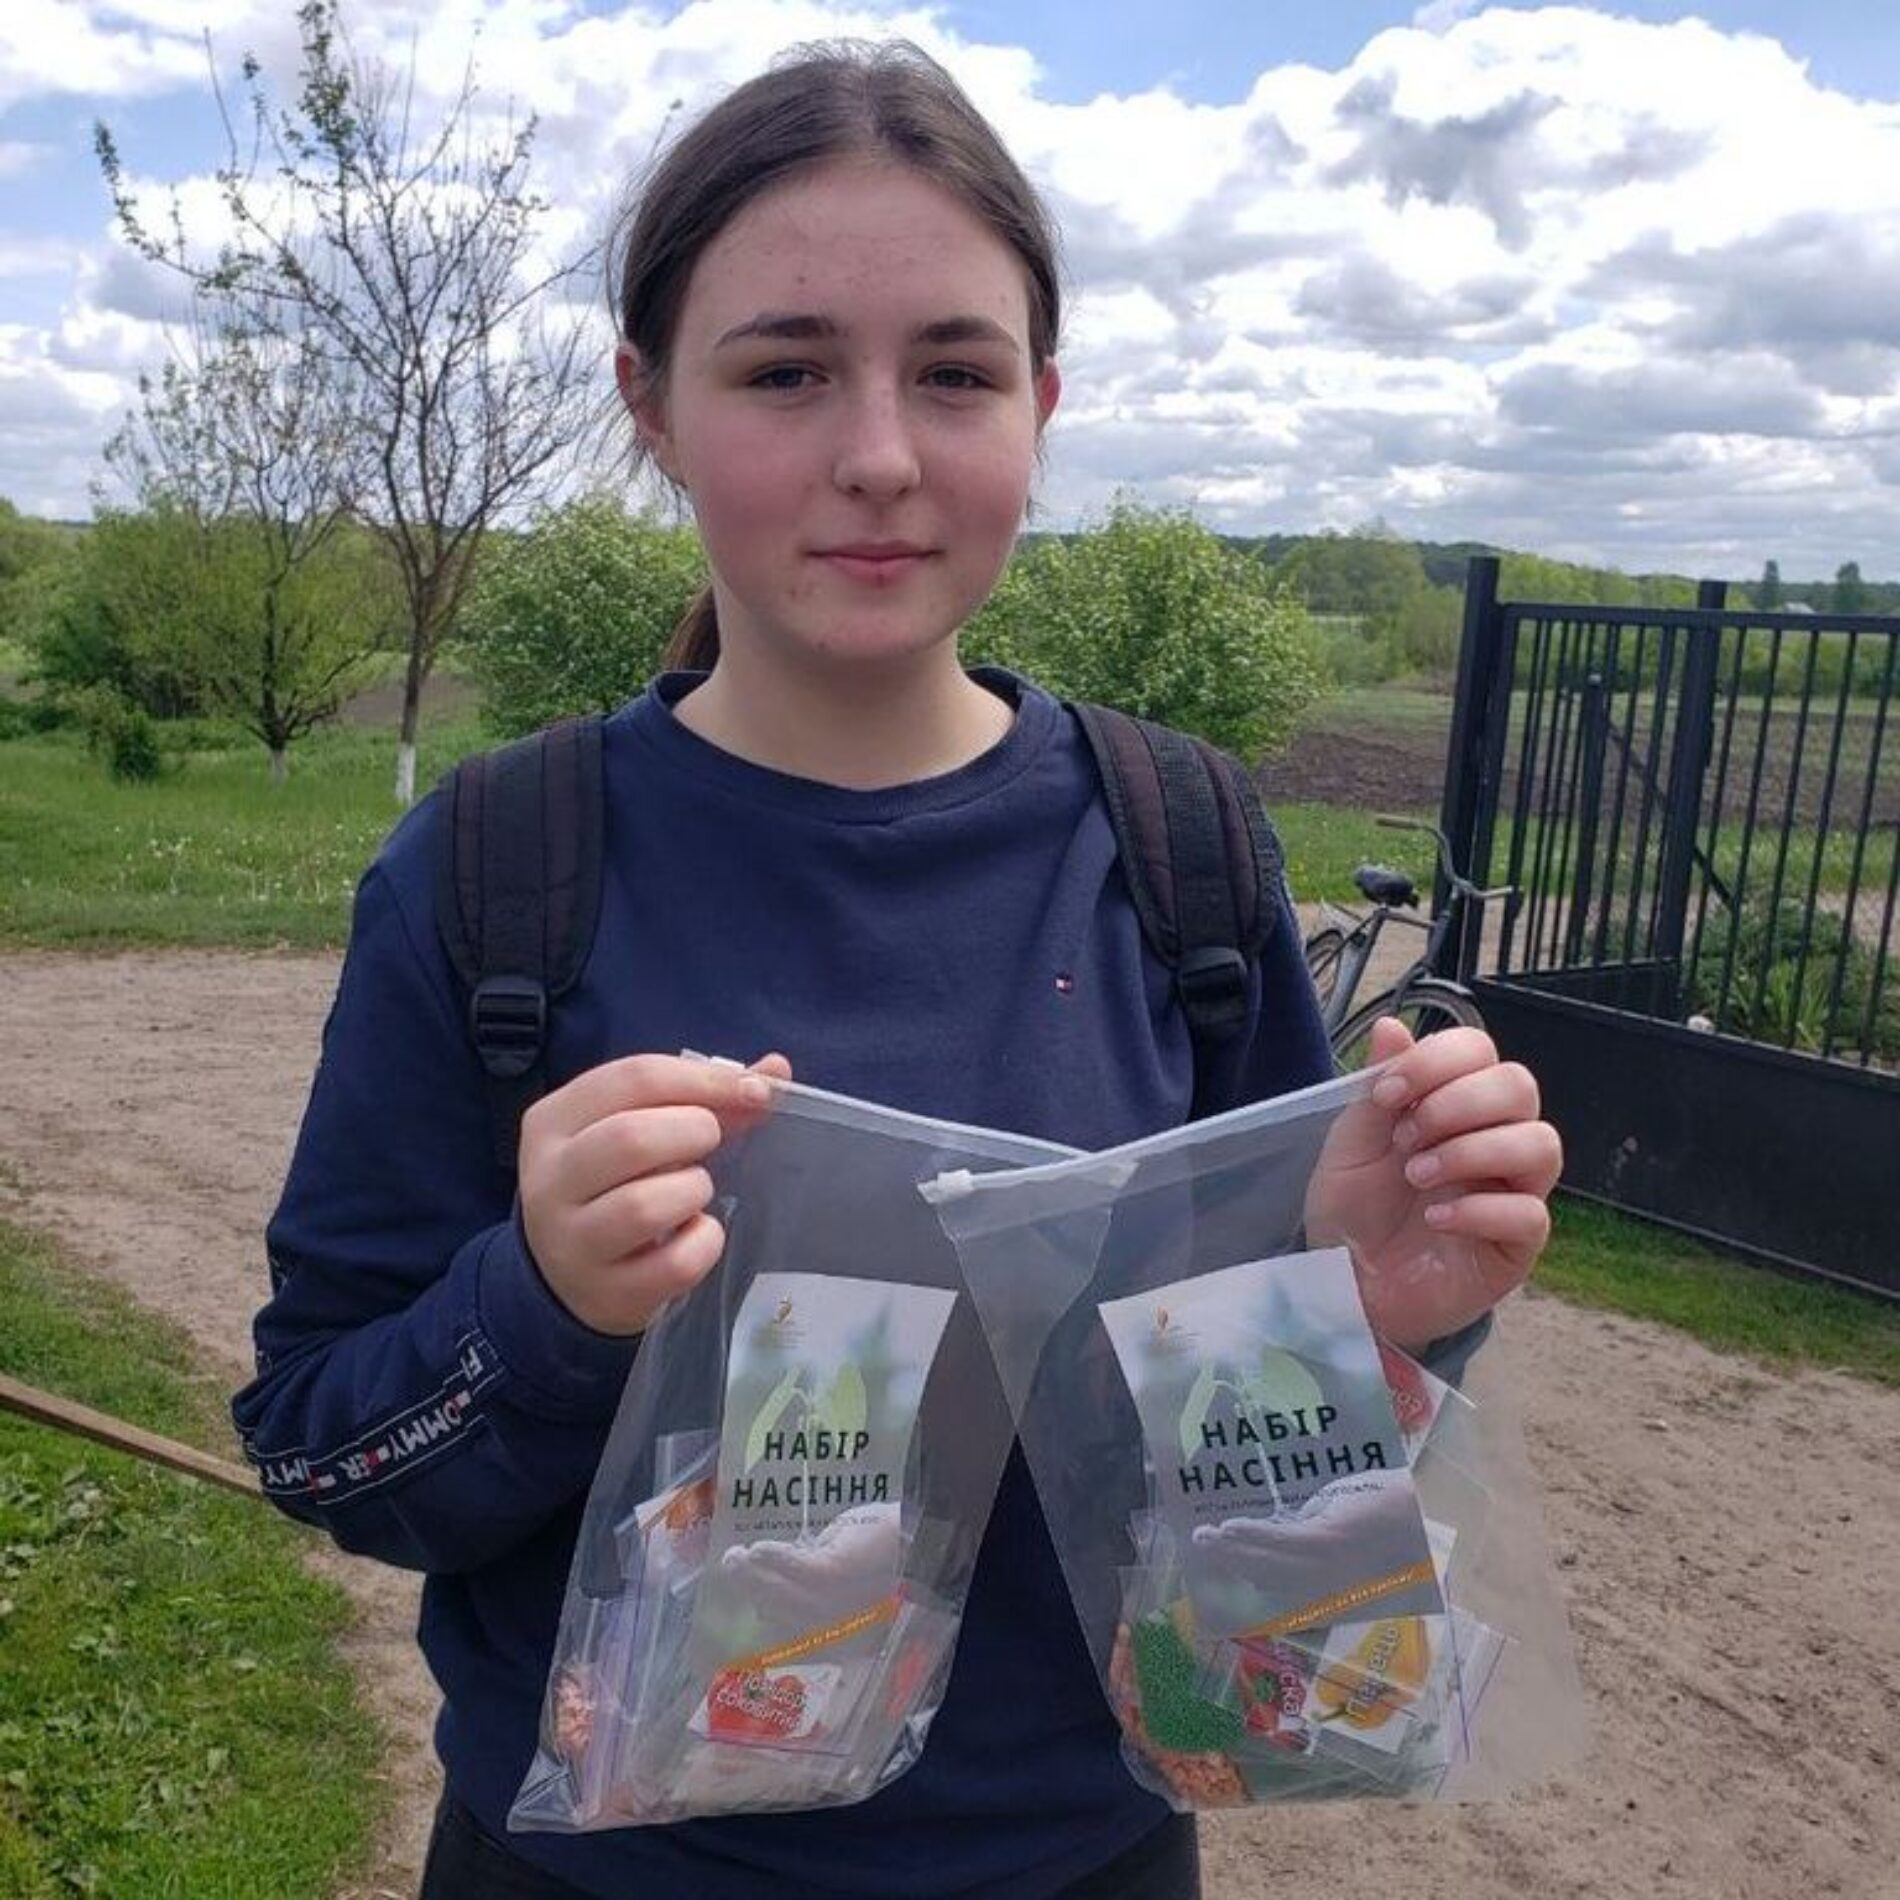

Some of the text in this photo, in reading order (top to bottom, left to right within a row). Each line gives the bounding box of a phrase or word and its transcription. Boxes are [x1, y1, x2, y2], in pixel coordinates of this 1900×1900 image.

[764, 1431, 870, 1461] НАБІР
[1201, 1405, 1338, 1449] НАБІР
[1179, 1441, 1387, 1494] НАСІННЯ
[731, 1473, 889, 1508] НАСІННЯ
